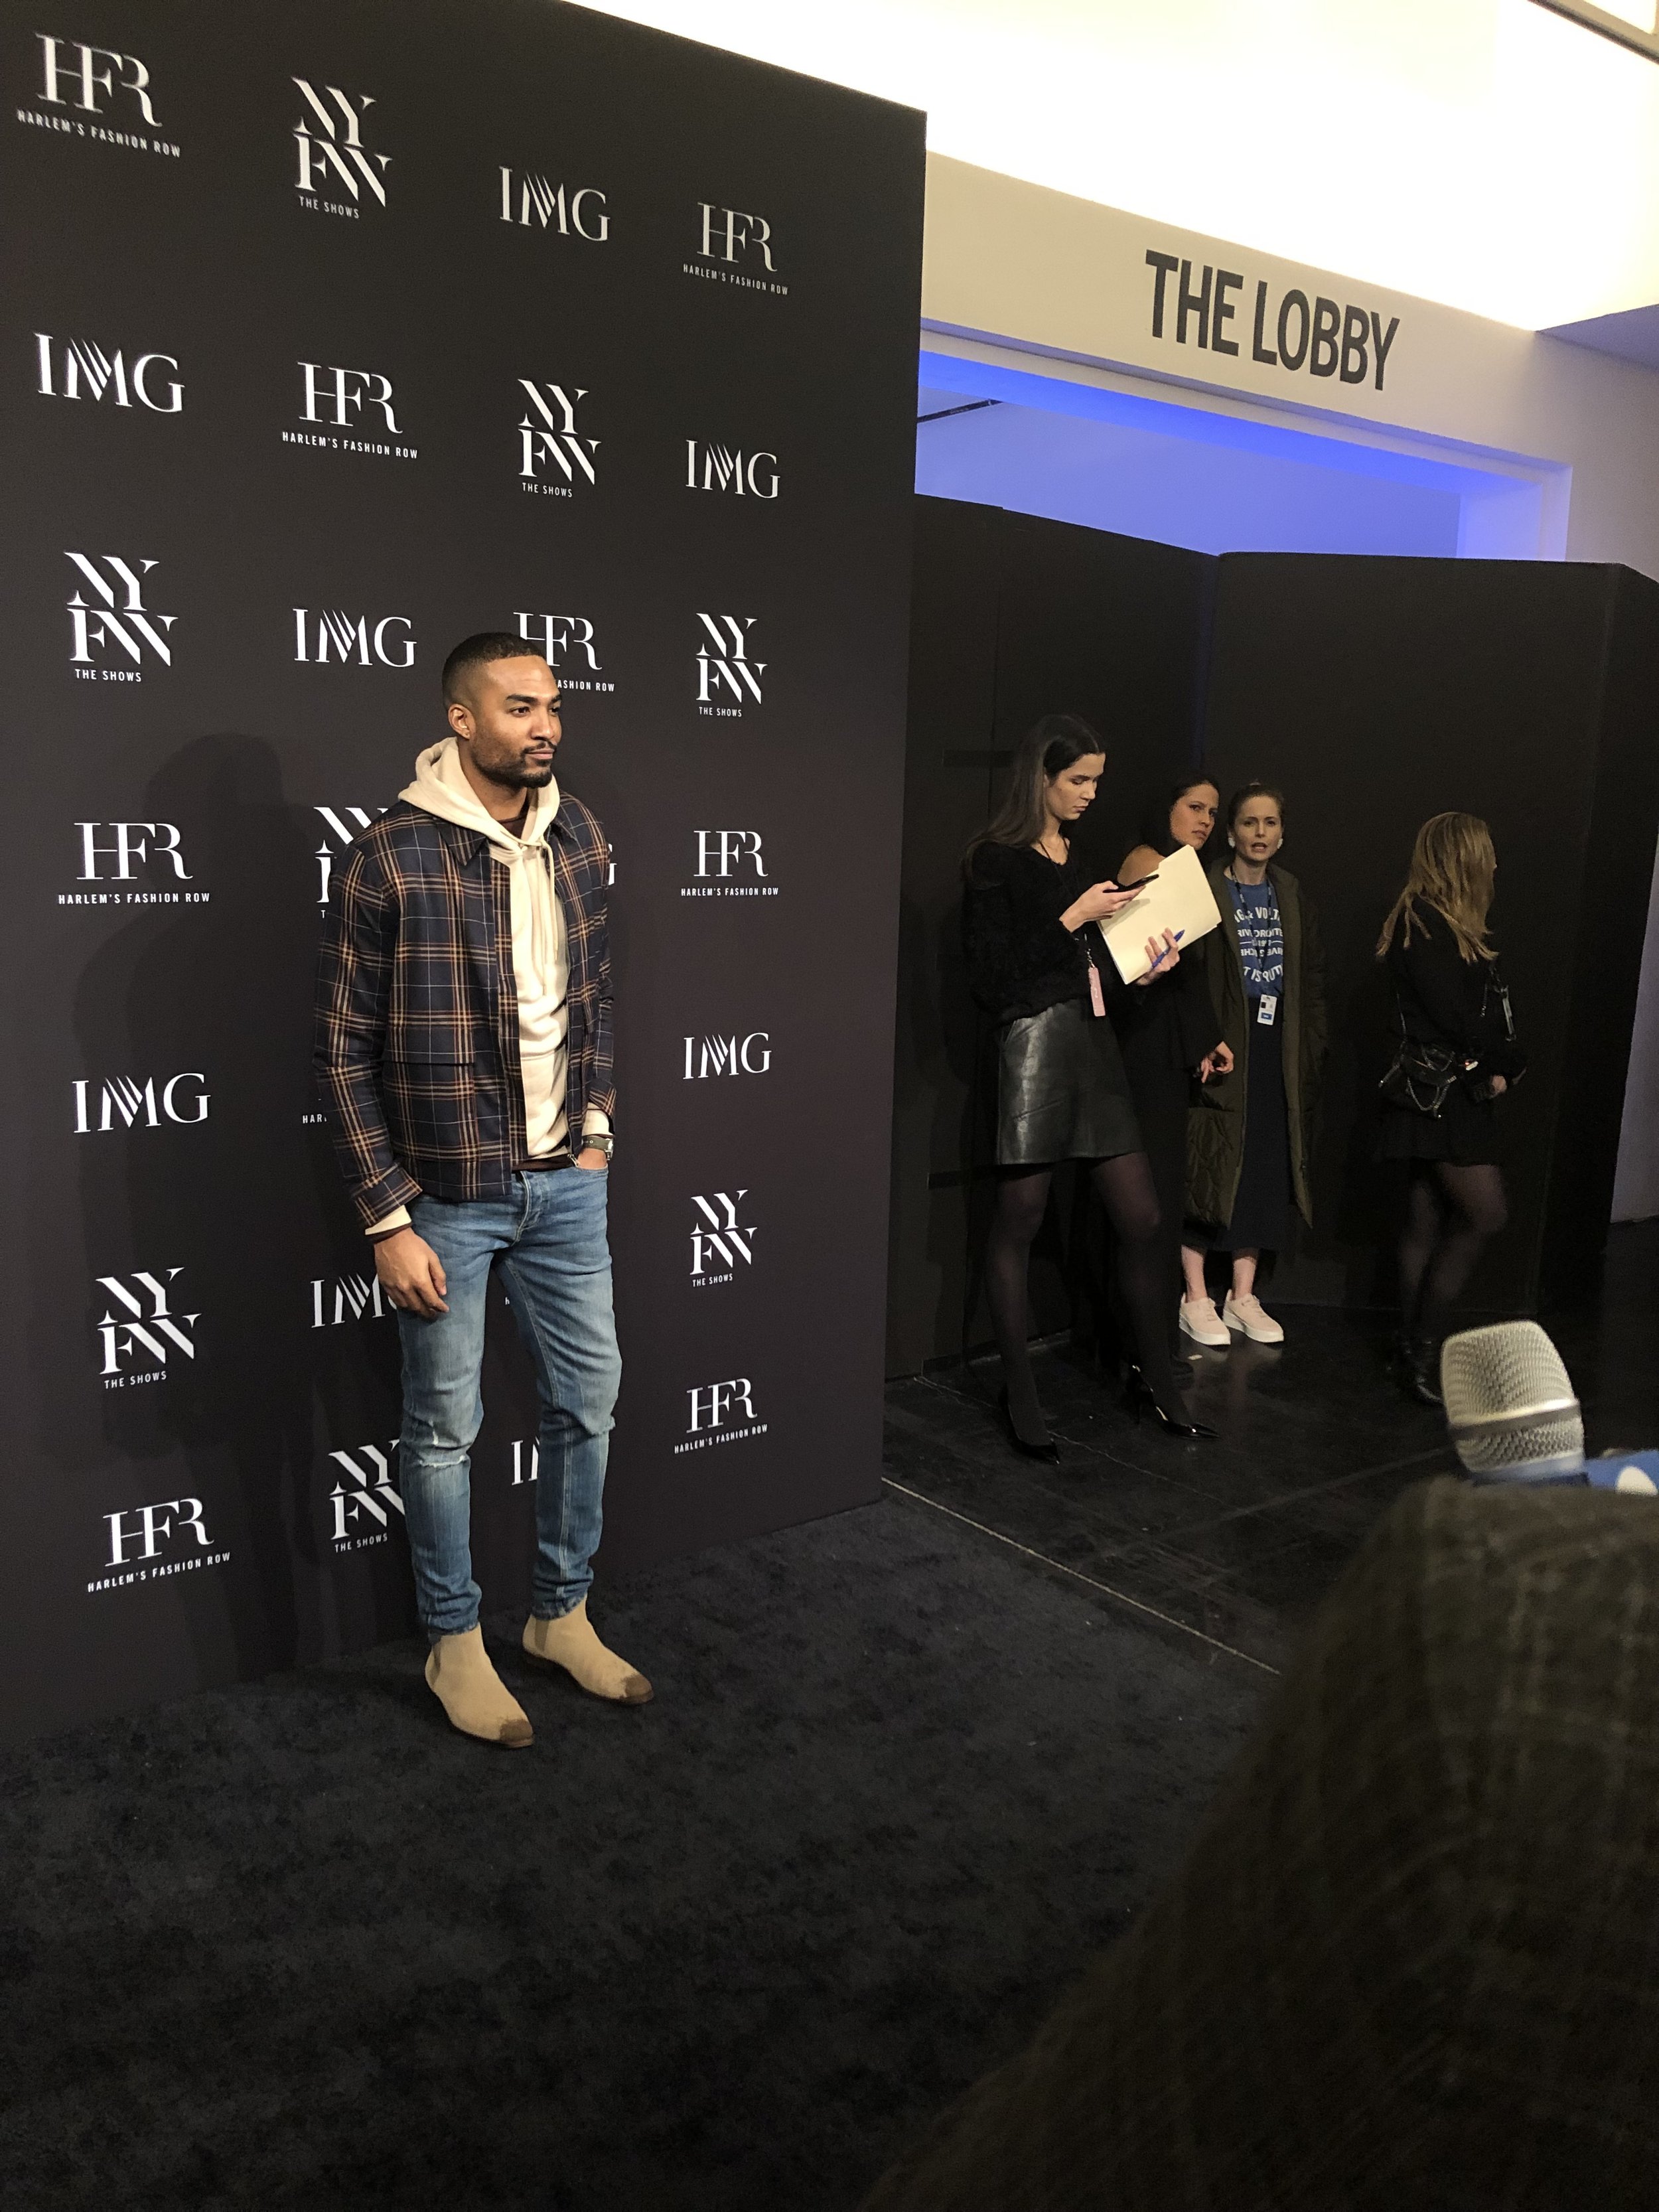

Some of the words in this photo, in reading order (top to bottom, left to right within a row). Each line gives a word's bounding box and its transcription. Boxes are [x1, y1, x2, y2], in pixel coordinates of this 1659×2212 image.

[36, 34, 162, 127] HFR
[17, 110, 84, 135] HARLEM'S
[92, 126, 147, 150] FASHION
[153, 141, 180, 157] ROW
[299, 196, 319, 210] THE
[324, 202, 359, 218] SHOWS
[500, 167, 610, 241] IMG
[695, 203, 777, 272] HFR
[684, 264, 725, 281] HARLEM'S
[731, 275, 766, 290] FASHION
[771, 284, 788, 295] ROW
[1146, 249, 1244, 356] THE
[1253, 280, 1400, 391] LOBBY
[35, 333, 184, 412] IMG
[298, 362, 403, 433] HFR
[283, 432, 337, 448] HARLEM'S
[344, 440, 390, 455] FASHION
[396, 447, 417, 459] ROW
[522, 482, 538, 493] THE
[543, 486, 572, 497] SHOWS
[686, 440, 780, 498] IMG
[293, 609, 417, 667] IMG
[75, 669, 96, 680] THE
[102, 670, 141, 682] SHOWS
[557, 680, 591, 691] ASHION
[596, 682, 614, 692] ROW
[717, 708, 741, 717] SHOWS
[74, 823, 192, 879] HFR
[693, 831, 768, 877] HFR
[58, 894, 120, 904] HARLEM'S
[127, 893, 179, 903] FASHION
[186, 893, 209, 902] ROW
[683, 1033, 771, 1079] IMG
[72, 1073, 210, 1133] IMG
[310, 1272, 397, 1328] IM
[693, 1278, 705, 1287] THE
[709, 1274, 733, 1284] SHOWS
[104, 1378, 124, 1389] THE
[130, 1371, 166, 1385] SHOWS
[686, 1378, 757, 1434] HFR
[675, 1438, 712, 1453] HARLEM'S
[717, 1429, 748, 1443] FASHION
[752, 1424, 767, 1434] ROW
[103, 1499, 214, 1567] HFR
[335, 1542, 351, 1552] THE
[357, 1533, 387, 1548] SHOWS
[88, 1571, 146, 1592] HARLEM'S
[153, 1559, 200, 1578] FASHION
[208, 1552, 230, 1565] ROW
